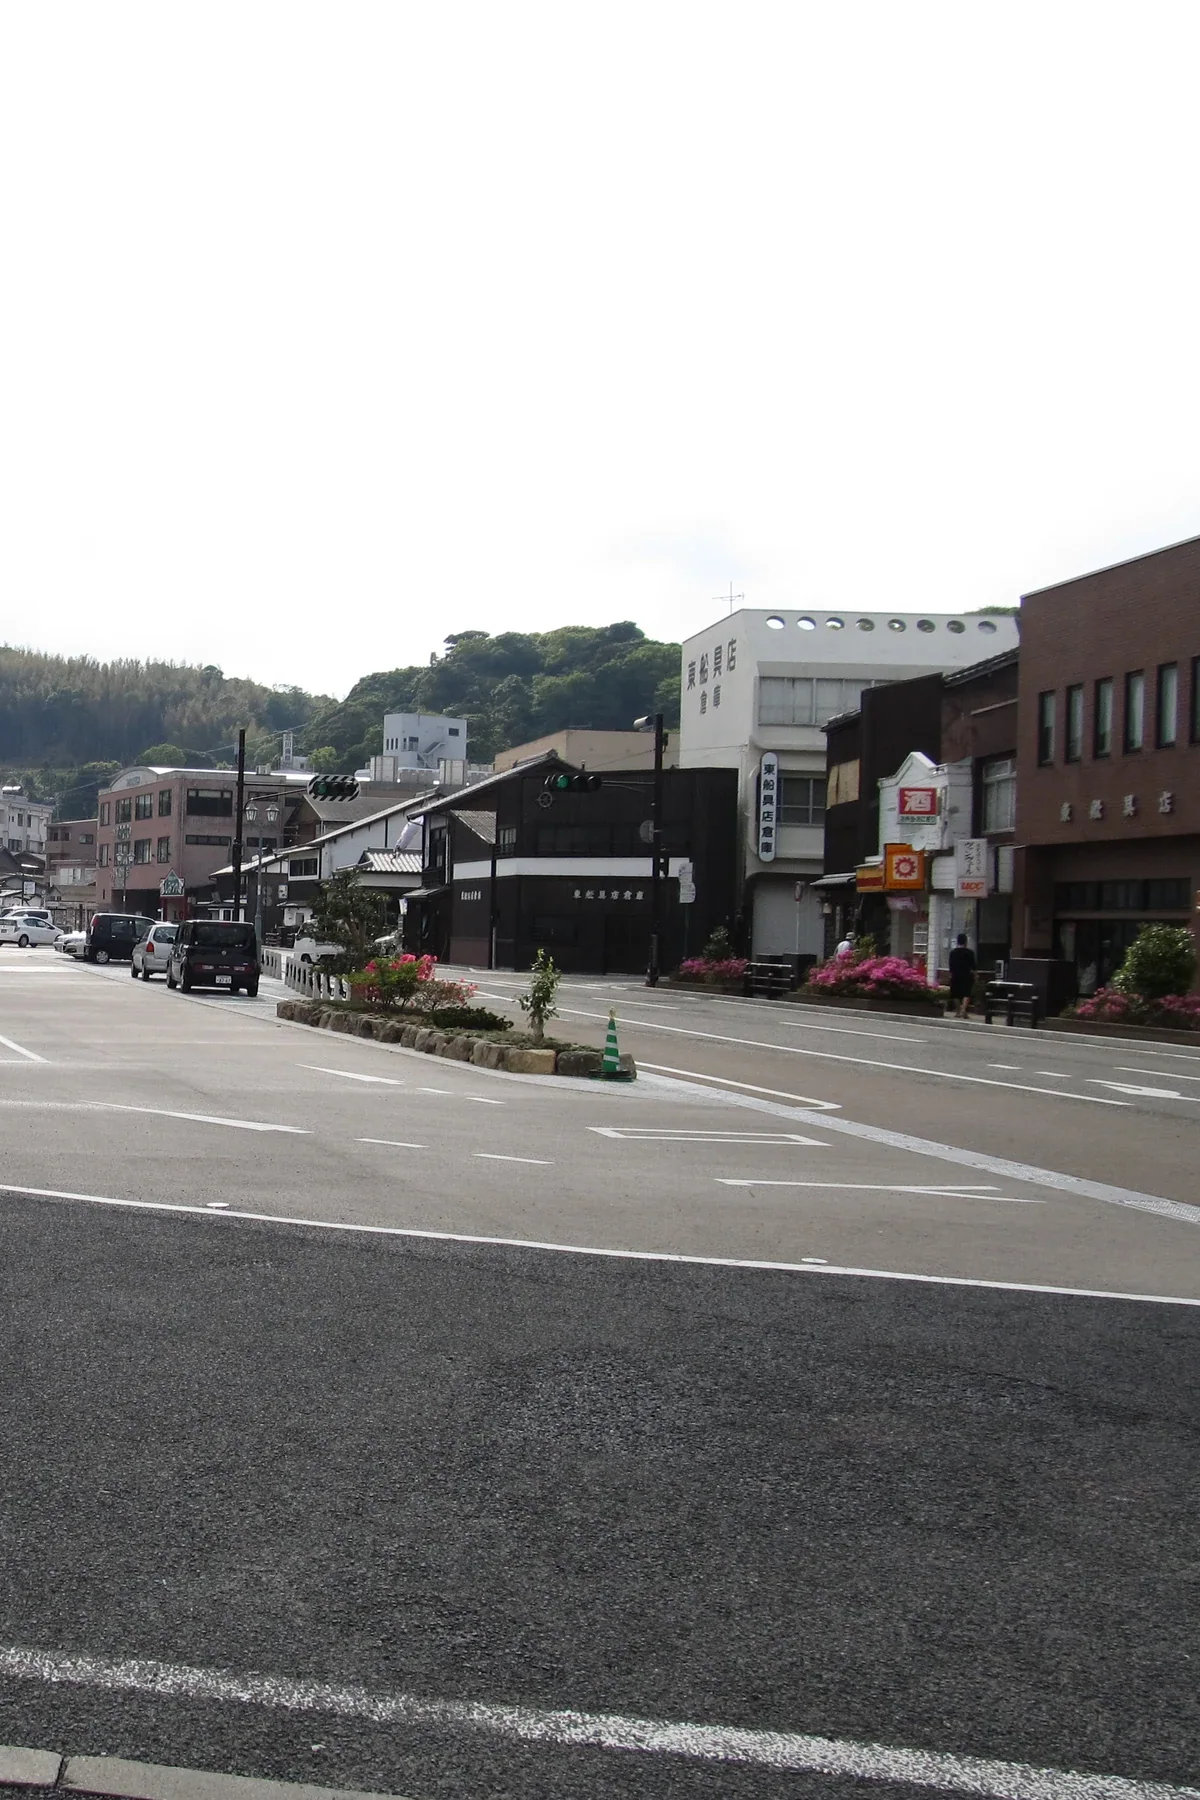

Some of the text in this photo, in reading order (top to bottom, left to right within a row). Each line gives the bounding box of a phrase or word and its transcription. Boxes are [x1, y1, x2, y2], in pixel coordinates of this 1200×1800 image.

[687, 637, 737, 691] 東船具店
[700, 683, 721, 715] 倉庫
[761, 763, 776, 853] 東船具店倉庫
[904, 790, 932, 812] 酒
[961, 881, 985, 892] UCC
